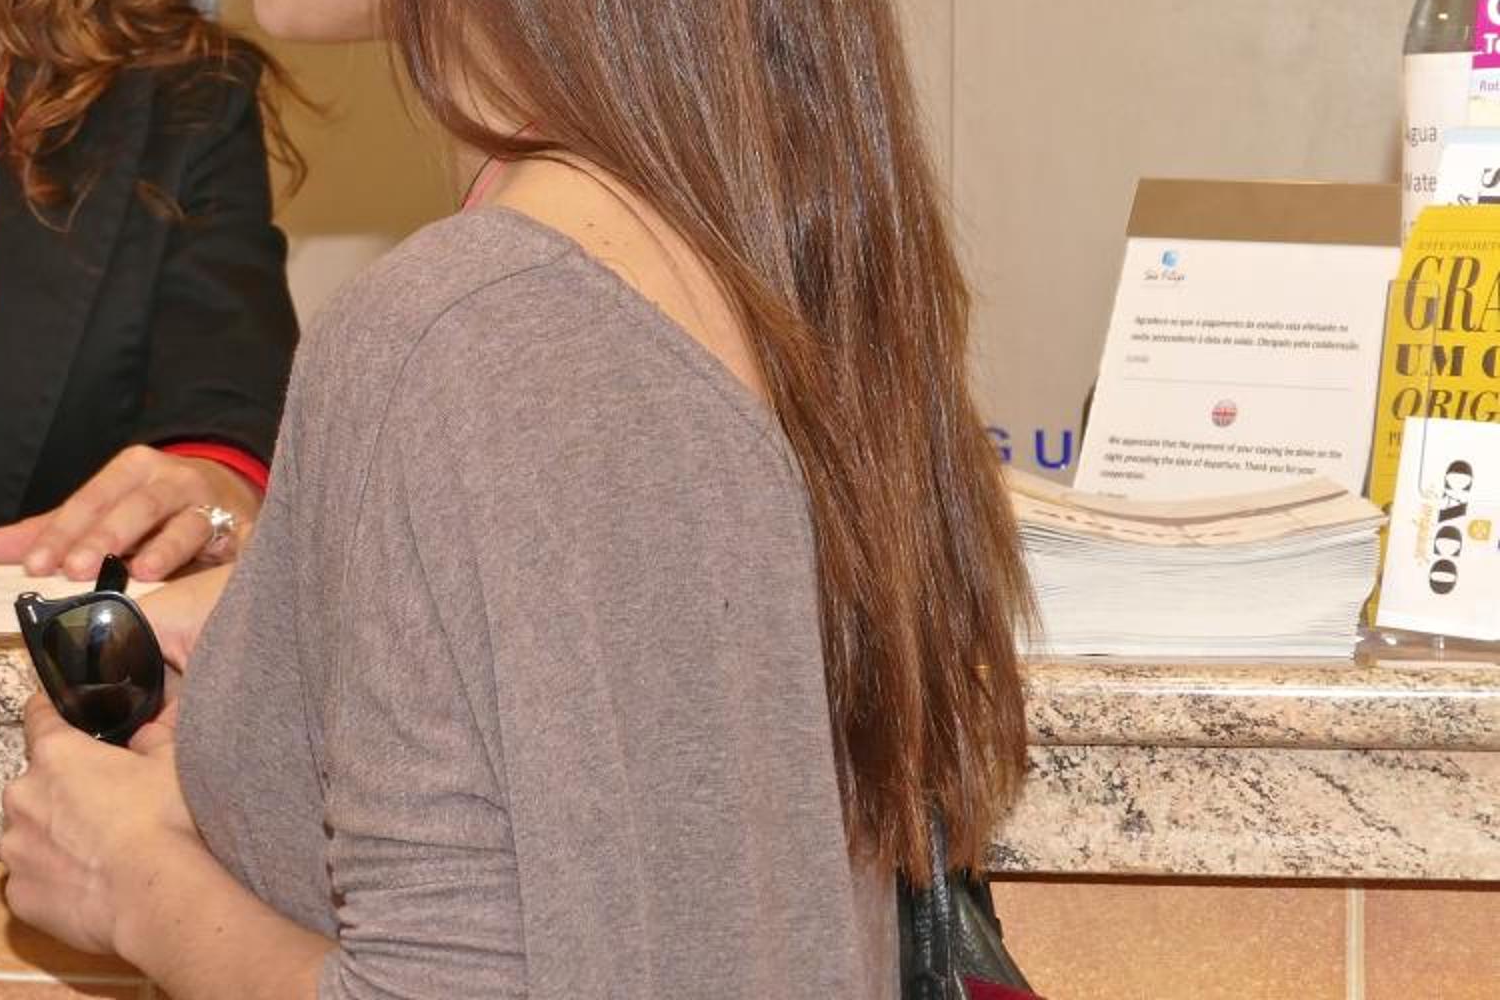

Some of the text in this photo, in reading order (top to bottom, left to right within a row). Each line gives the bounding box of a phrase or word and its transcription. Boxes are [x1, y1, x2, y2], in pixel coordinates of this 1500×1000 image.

[1405, 126, 1438, 148] gua
[1395, 343, 1465, 378] UM
[1391, 387, 1500, 423] ORIG
[1428, 459, 1473, 595] CACO
